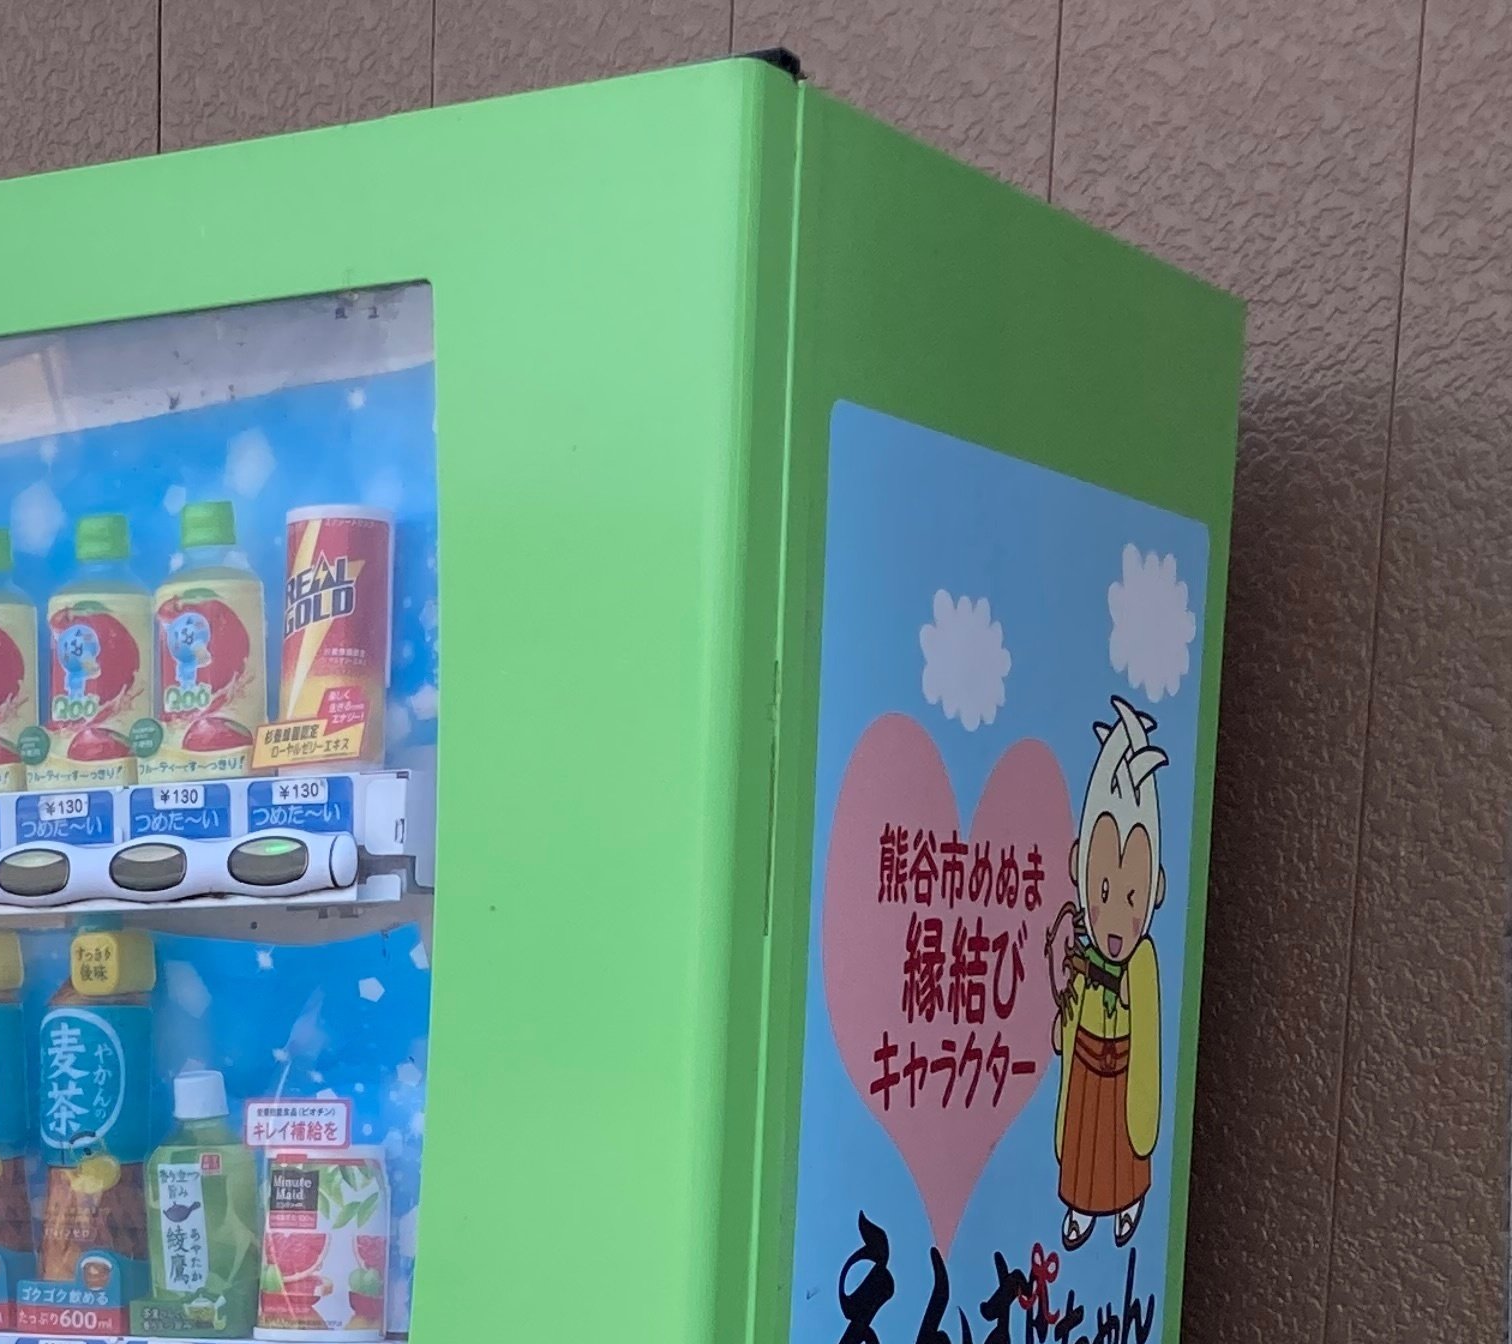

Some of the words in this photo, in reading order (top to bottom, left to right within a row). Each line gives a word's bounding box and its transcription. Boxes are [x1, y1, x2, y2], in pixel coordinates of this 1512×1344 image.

[45, 797, 84, 814] ¥130
[159, 788, 199, 806] ¥130
[279, 782, 320, 800] ¥130
[878, 822, 1045, 911] 熊谷市めぬま
[902, 911, 1029, 1025] 縁結び
[47, 1022, 90, 1136] 麦茶
[92, 1043, 114, 1120] やかんの
[869, 1030, 1036, 1111] キャラクター
[253, 1121, 339, 1142] キレイ補給を
[273, 1174, 314, 1188] Minute
[275, 1187, 306, 1202] Maid
[166, 1225, 191, 1285] 綾鷹
